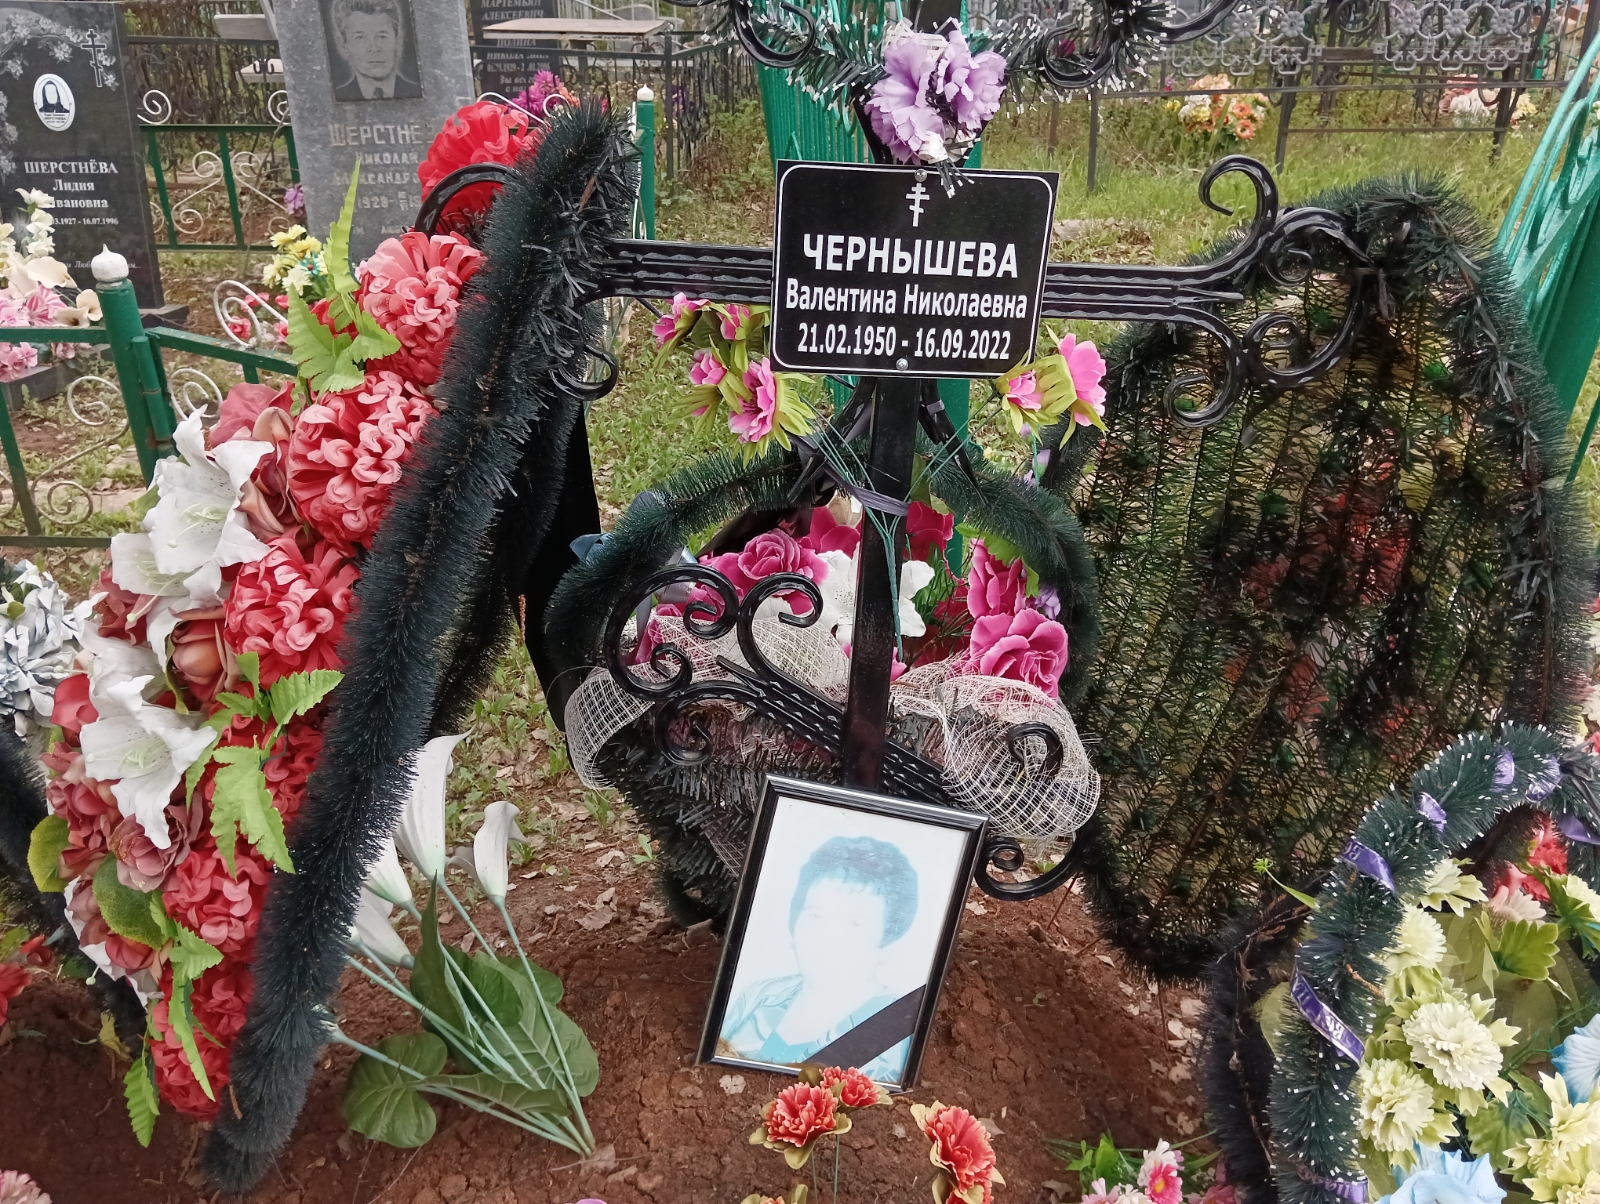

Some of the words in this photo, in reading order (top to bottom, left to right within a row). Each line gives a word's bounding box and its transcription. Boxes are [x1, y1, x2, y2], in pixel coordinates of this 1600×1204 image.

[23, 159, 119, 174] ШЕРСТНЁВА
[52, 179, 95, 192] Лидия
[53, 199, 109, 208] вановна
[83, 217, 119, 226] 16.07.1996
[803, 233, 1018, 278] ЧЕРНЫШЕВА
[786, 278, 896, 314] Валентина
[903, 284, 1028, 319] Николаевна
[797, 323, 896, 356] 21.02.1950
[914, 328, 1011, 360] 16.09.2022
